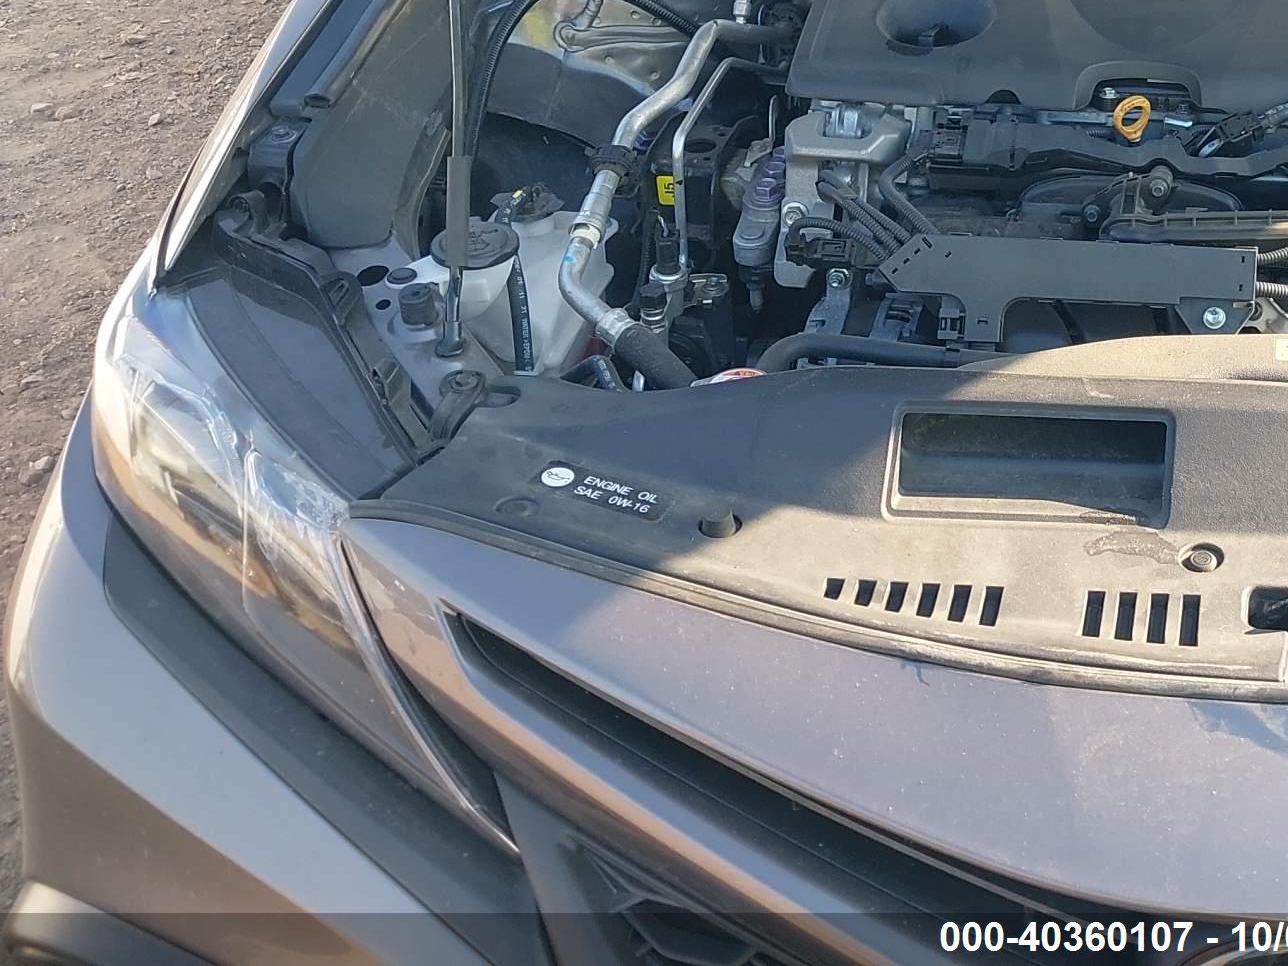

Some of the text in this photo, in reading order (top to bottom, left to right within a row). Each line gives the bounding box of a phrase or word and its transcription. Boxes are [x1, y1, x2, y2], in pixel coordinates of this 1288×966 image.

[574, 486, 650, 513] SAE 0W-16
[583, 476, 658, 503] ENGINE OIL
